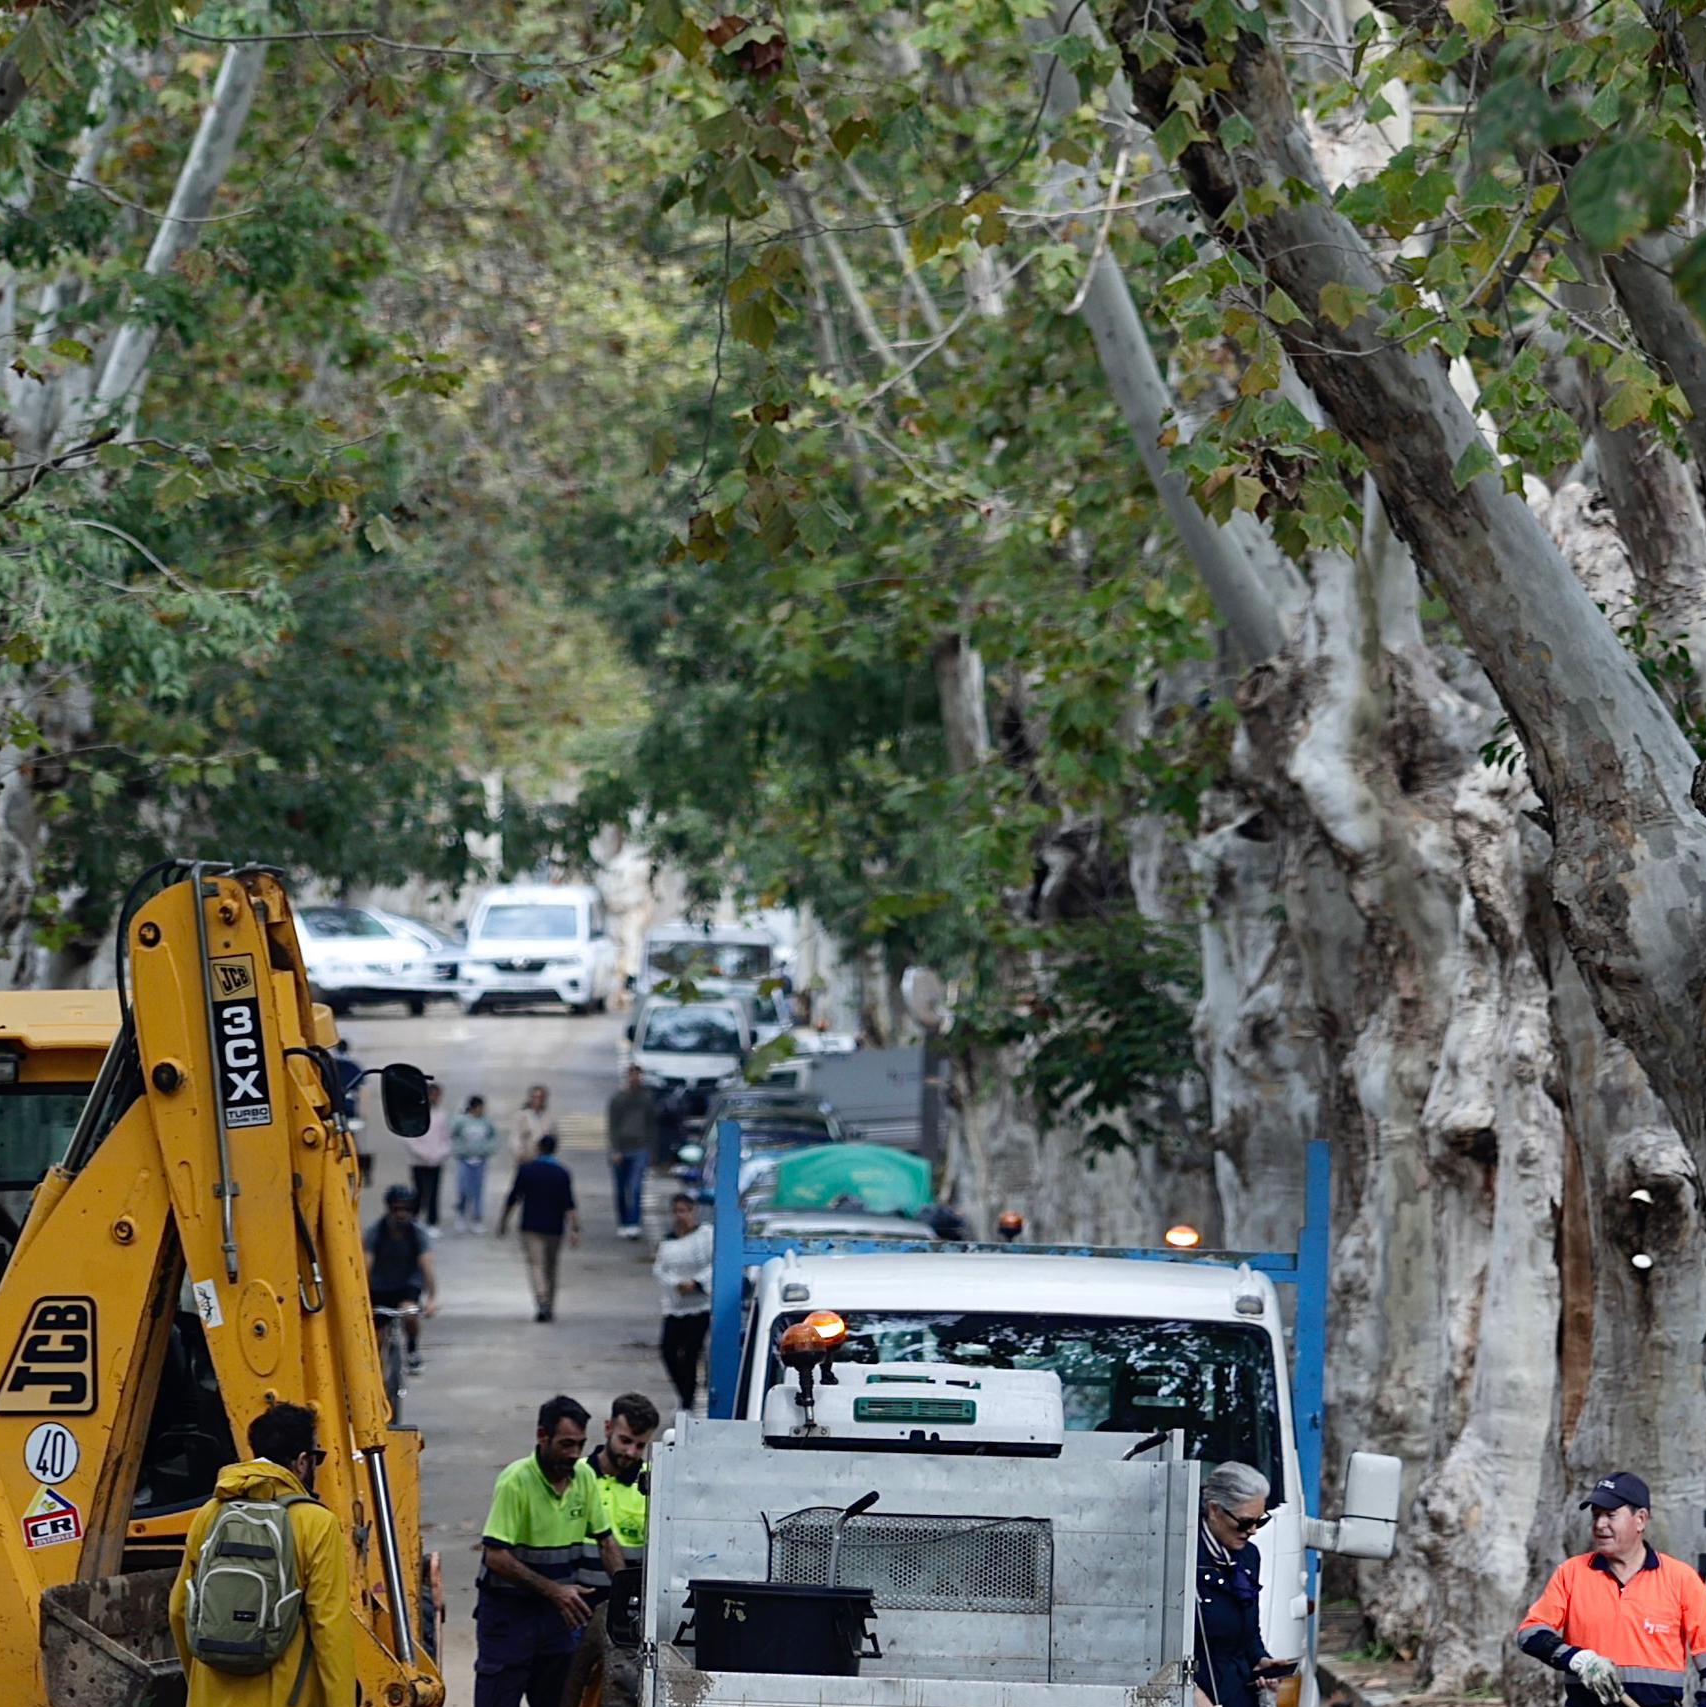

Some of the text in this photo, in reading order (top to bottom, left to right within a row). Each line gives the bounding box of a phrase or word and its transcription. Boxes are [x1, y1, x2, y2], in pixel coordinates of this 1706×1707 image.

[219, 966, 249, 992] JCB
[222, 1005, 264, 1101] 3CX
[227, 1107, 269, 1119] TURBO
[7, 1304, 88, 1404] JCB
[35, 1428, 67, 1478] 40
[30, 1517, 73, 1538] CR
